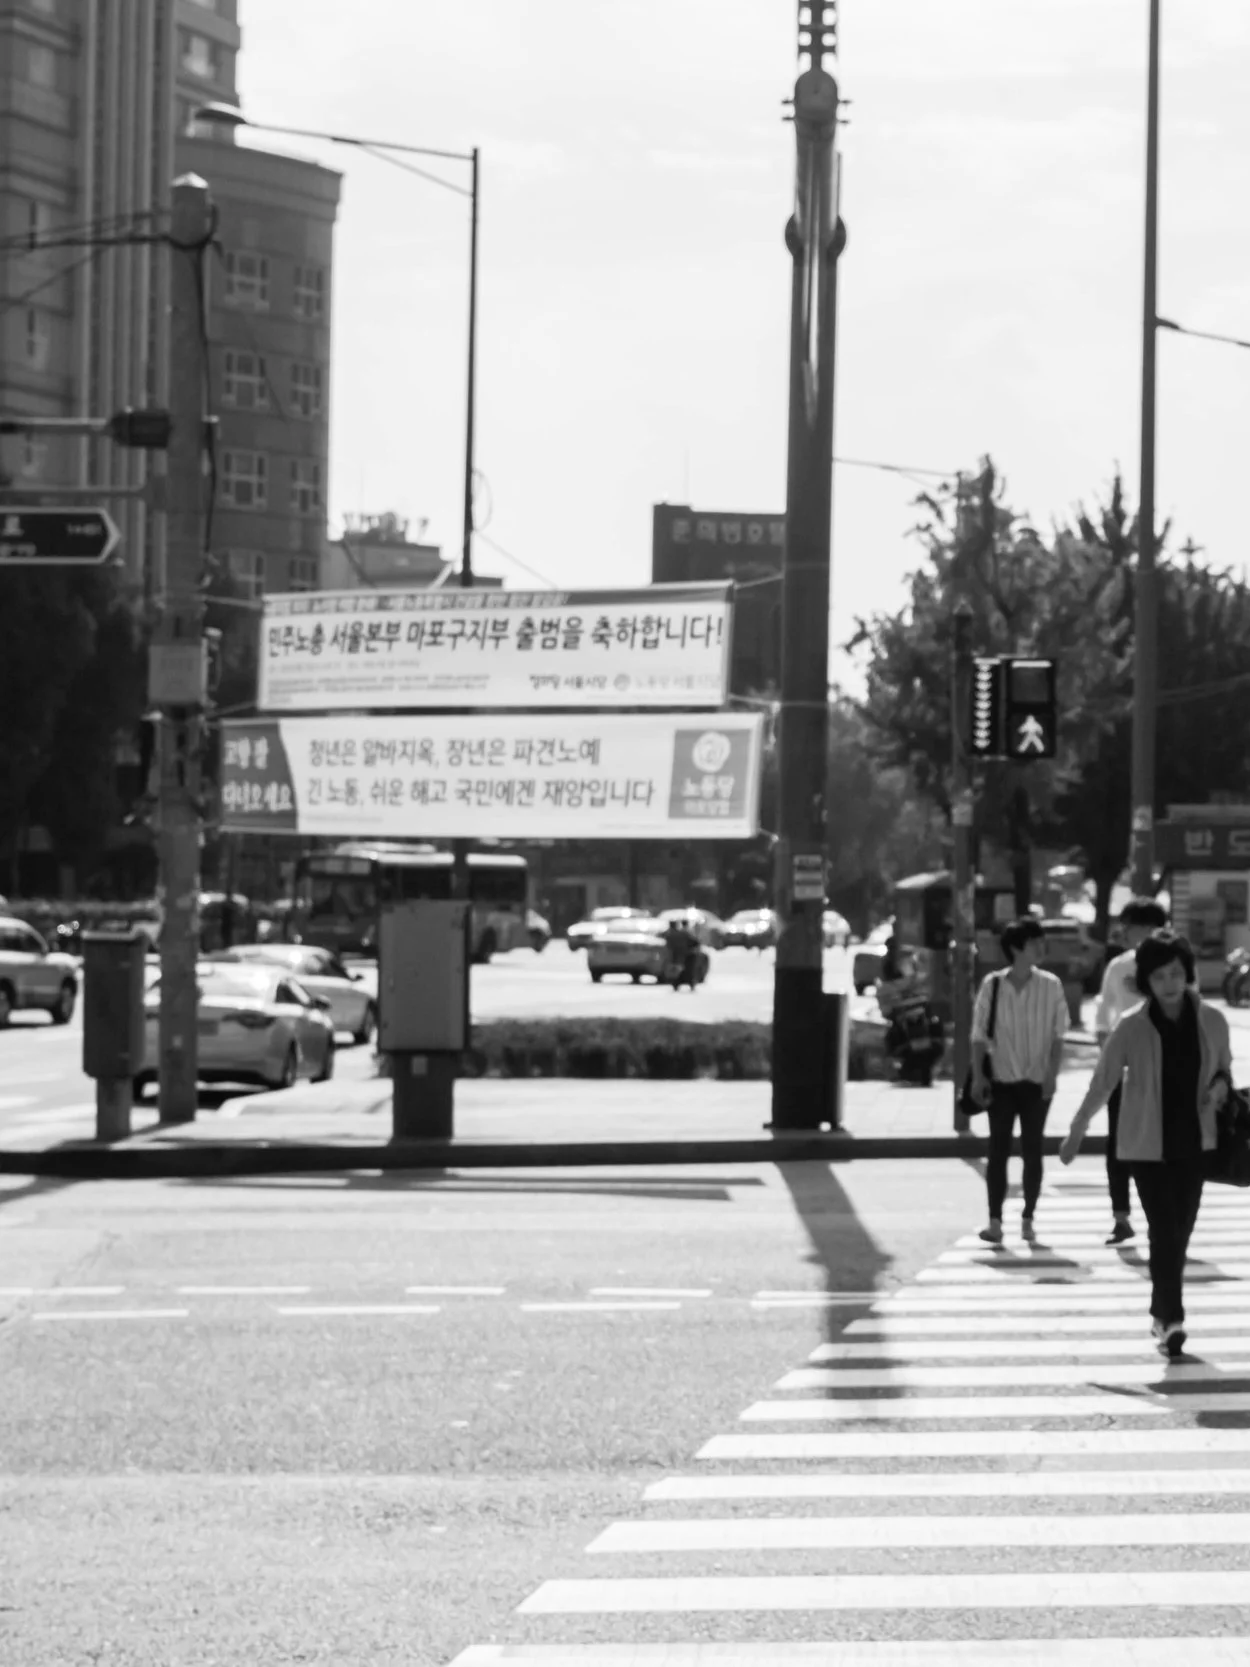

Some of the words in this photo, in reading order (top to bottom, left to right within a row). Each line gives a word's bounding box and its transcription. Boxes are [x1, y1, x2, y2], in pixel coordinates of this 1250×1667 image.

[268, 621, 325, 657] 민주노총
[330, 620, 401, 654] 서울본부
[406, 617, 510, 651] 마포구지부
[516, 615, 584, 650] 출범을
[591, 614, 724, 650] 축하합니다!
[309, 739, 357, 767] 청년은
[362, 737, 440, 769] 알바지옥,
[447, 738, 506, 767] 장년은
[513, 736, 601, 767] 파견노예
[308, 778, 322, 806] 긴
[370, 778, 404, 806] 쉬운
[410, 779, 448, 806] 해고
[454, 778, 535, 807] 국민에겐
[542, 779, 655, 808] 재앙입니다
